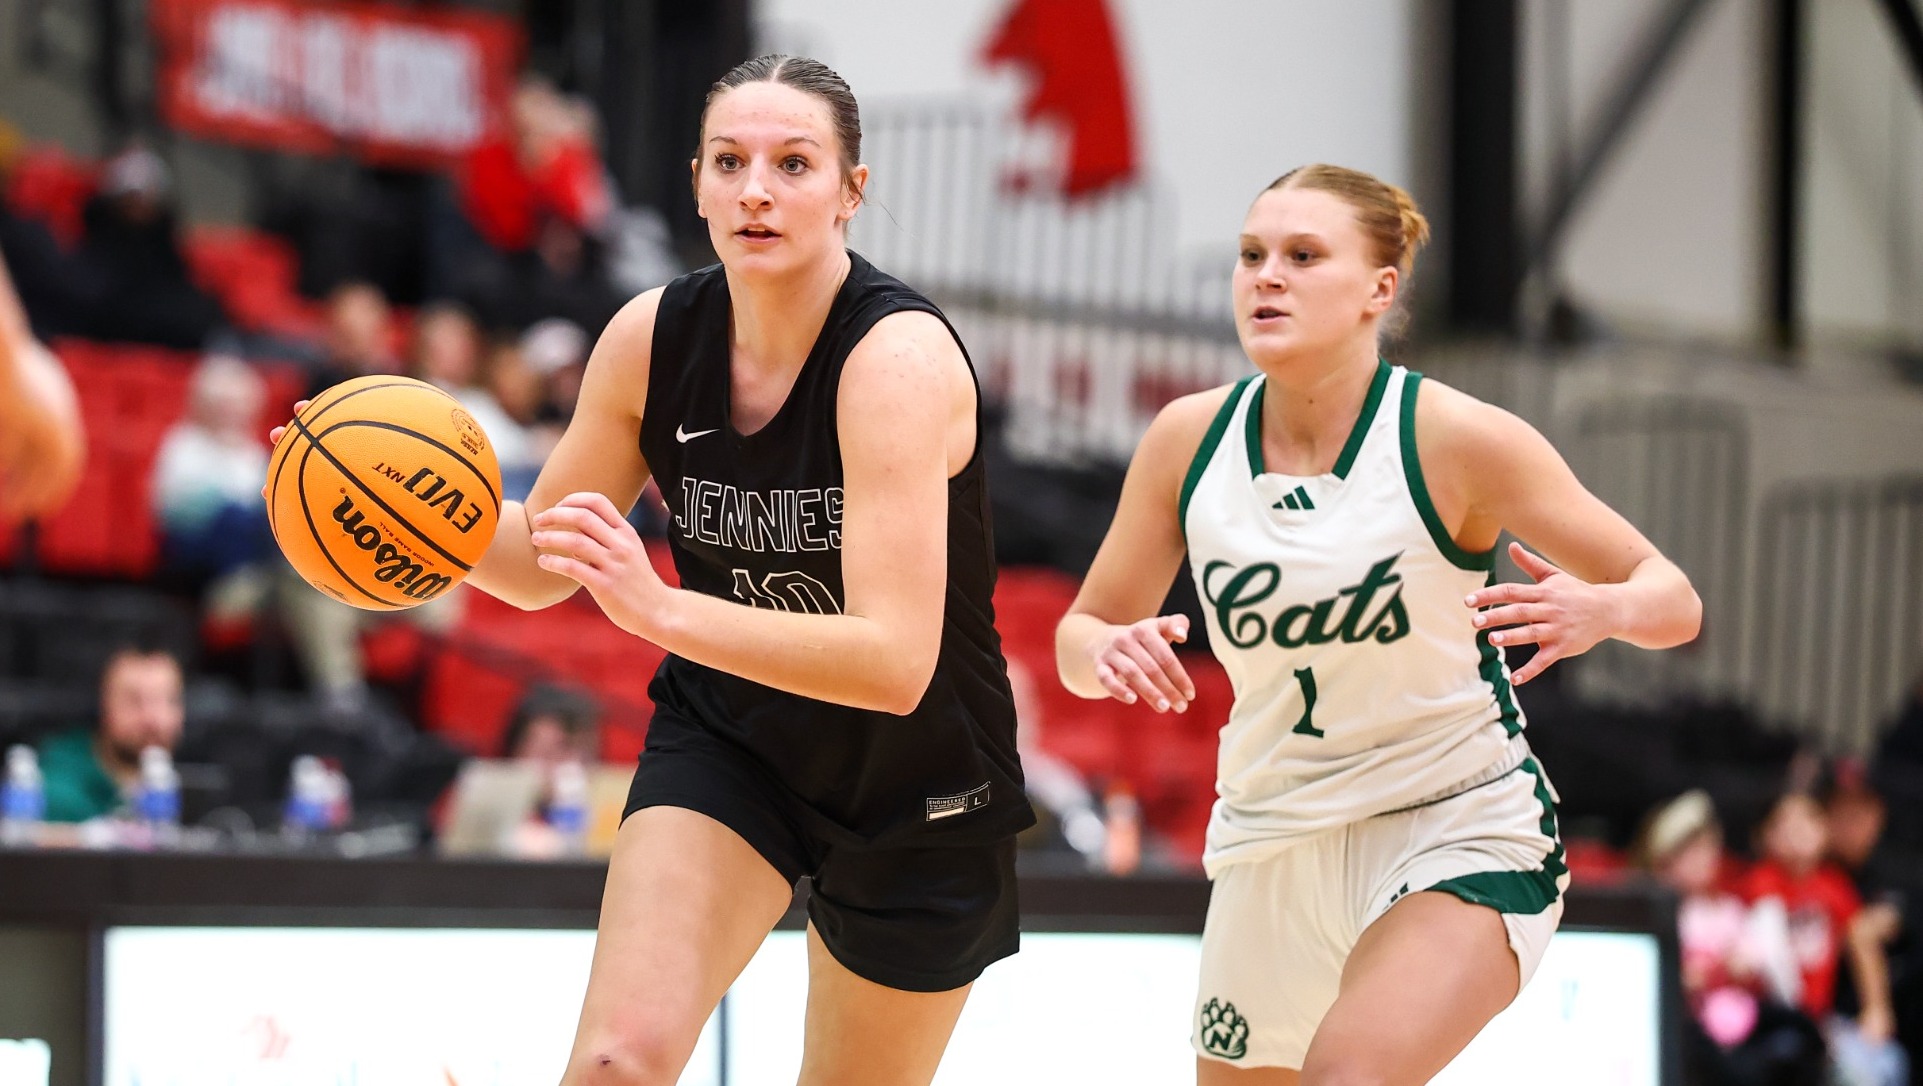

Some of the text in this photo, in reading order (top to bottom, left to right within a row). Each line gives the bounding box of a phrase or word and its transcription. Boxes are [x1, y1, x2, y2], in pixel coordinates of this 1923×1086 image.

[372, 462, 406, 484] NXT
[675, 476, 844, 553] JENNIES
[332, 495, 453, 600] Wilson
[380, 522, 435, 567] INDOOR GAME BALL
[1203, 549, 1411, 649] Cats
[1292, 666, 1325, 739] 1
[974, 796, 982, 806] L
[1209, 1030, 1232, 1051] N
